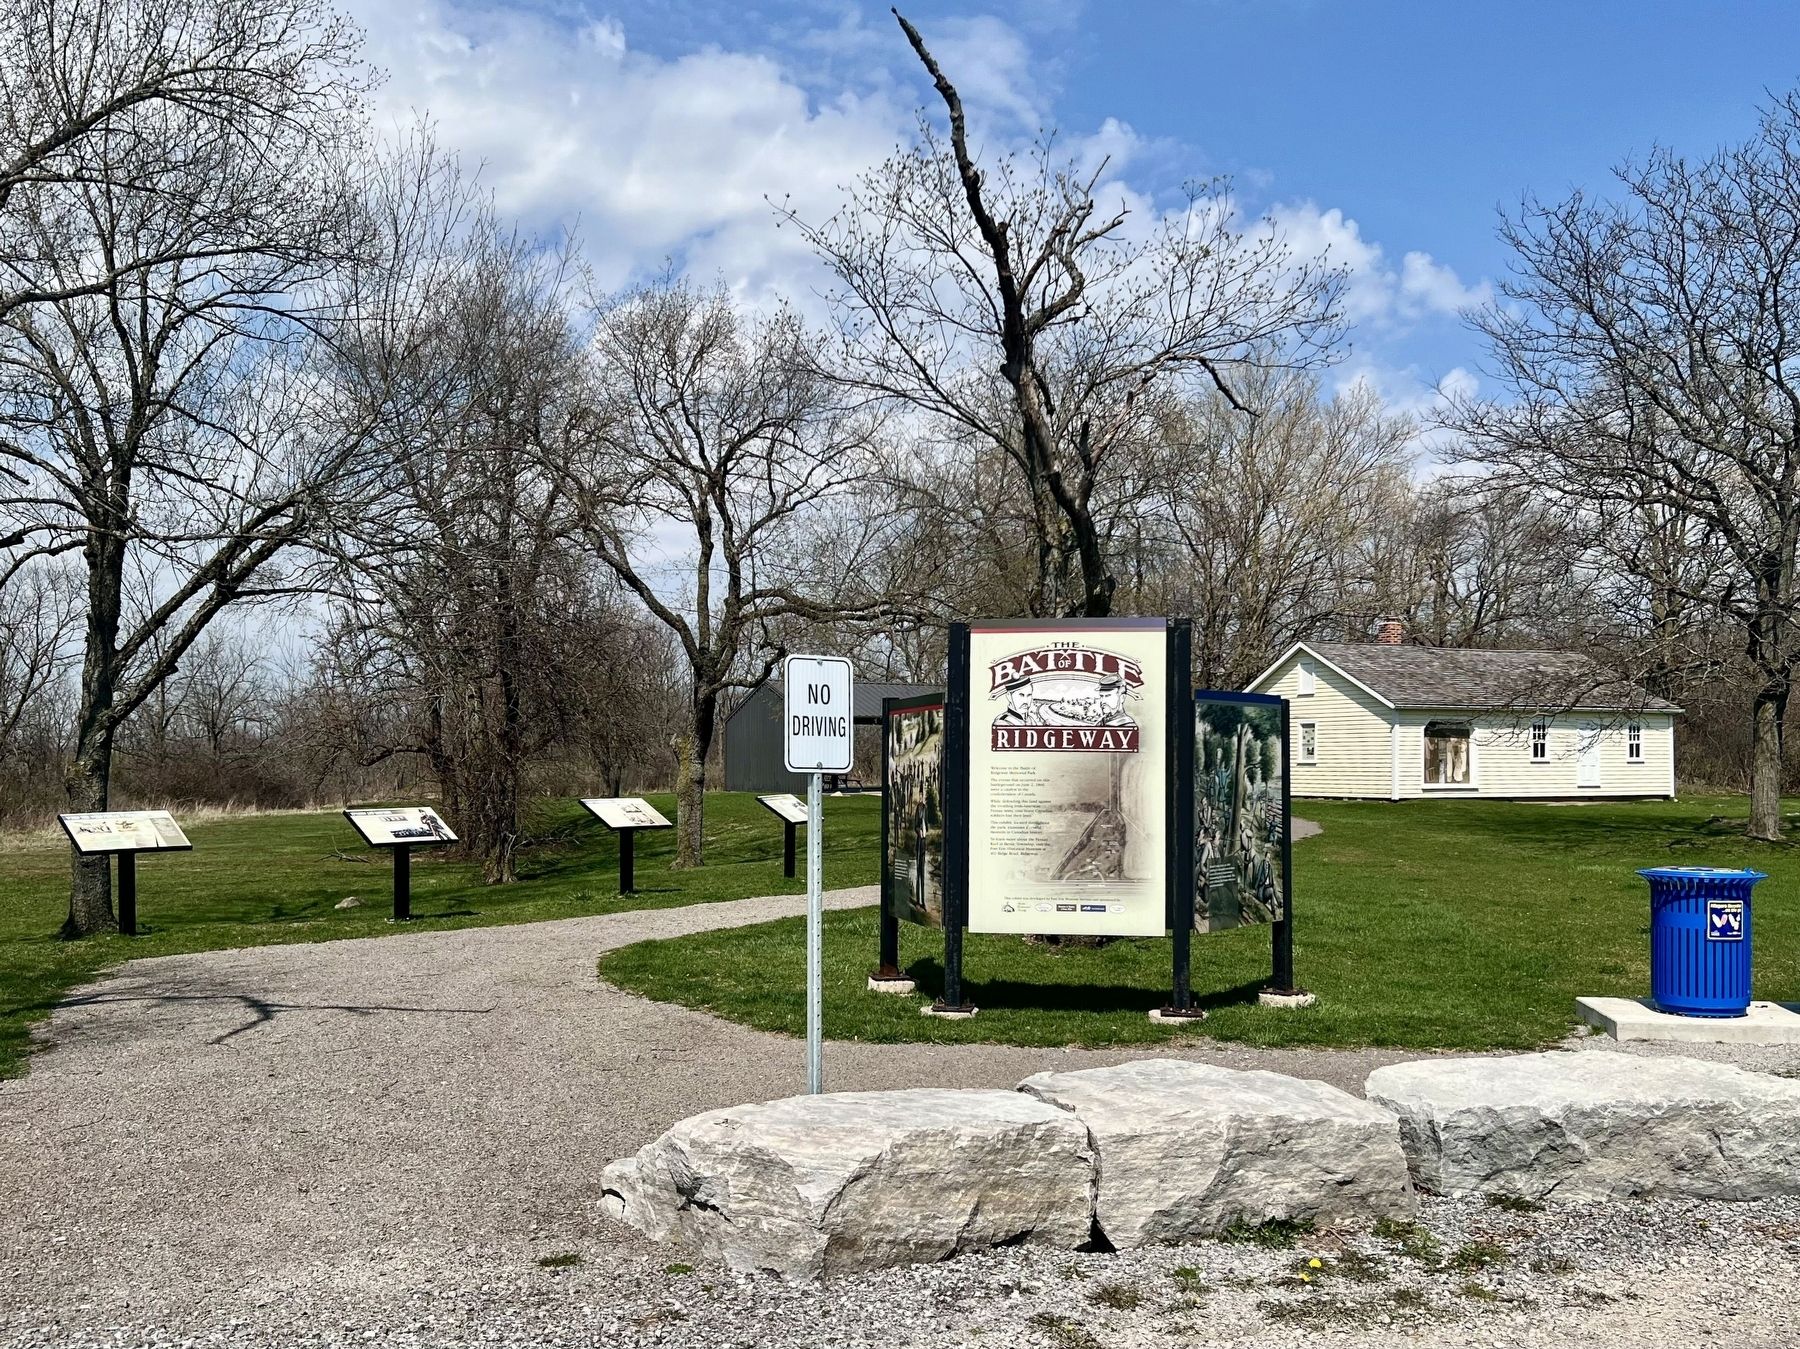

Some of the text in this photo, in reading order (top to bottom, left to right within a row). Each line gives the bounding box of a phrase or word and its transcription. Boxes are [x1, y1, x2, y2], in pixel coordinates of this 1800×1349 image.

[991, 648, 1144, 690] BATTLE
[1058, 660, 1071, 668] OF
[808, 684, 830, 705] NO
[793, 715, 846, 738] DRIVING
[997, 730, 1133, 749] RIDGEWAY
